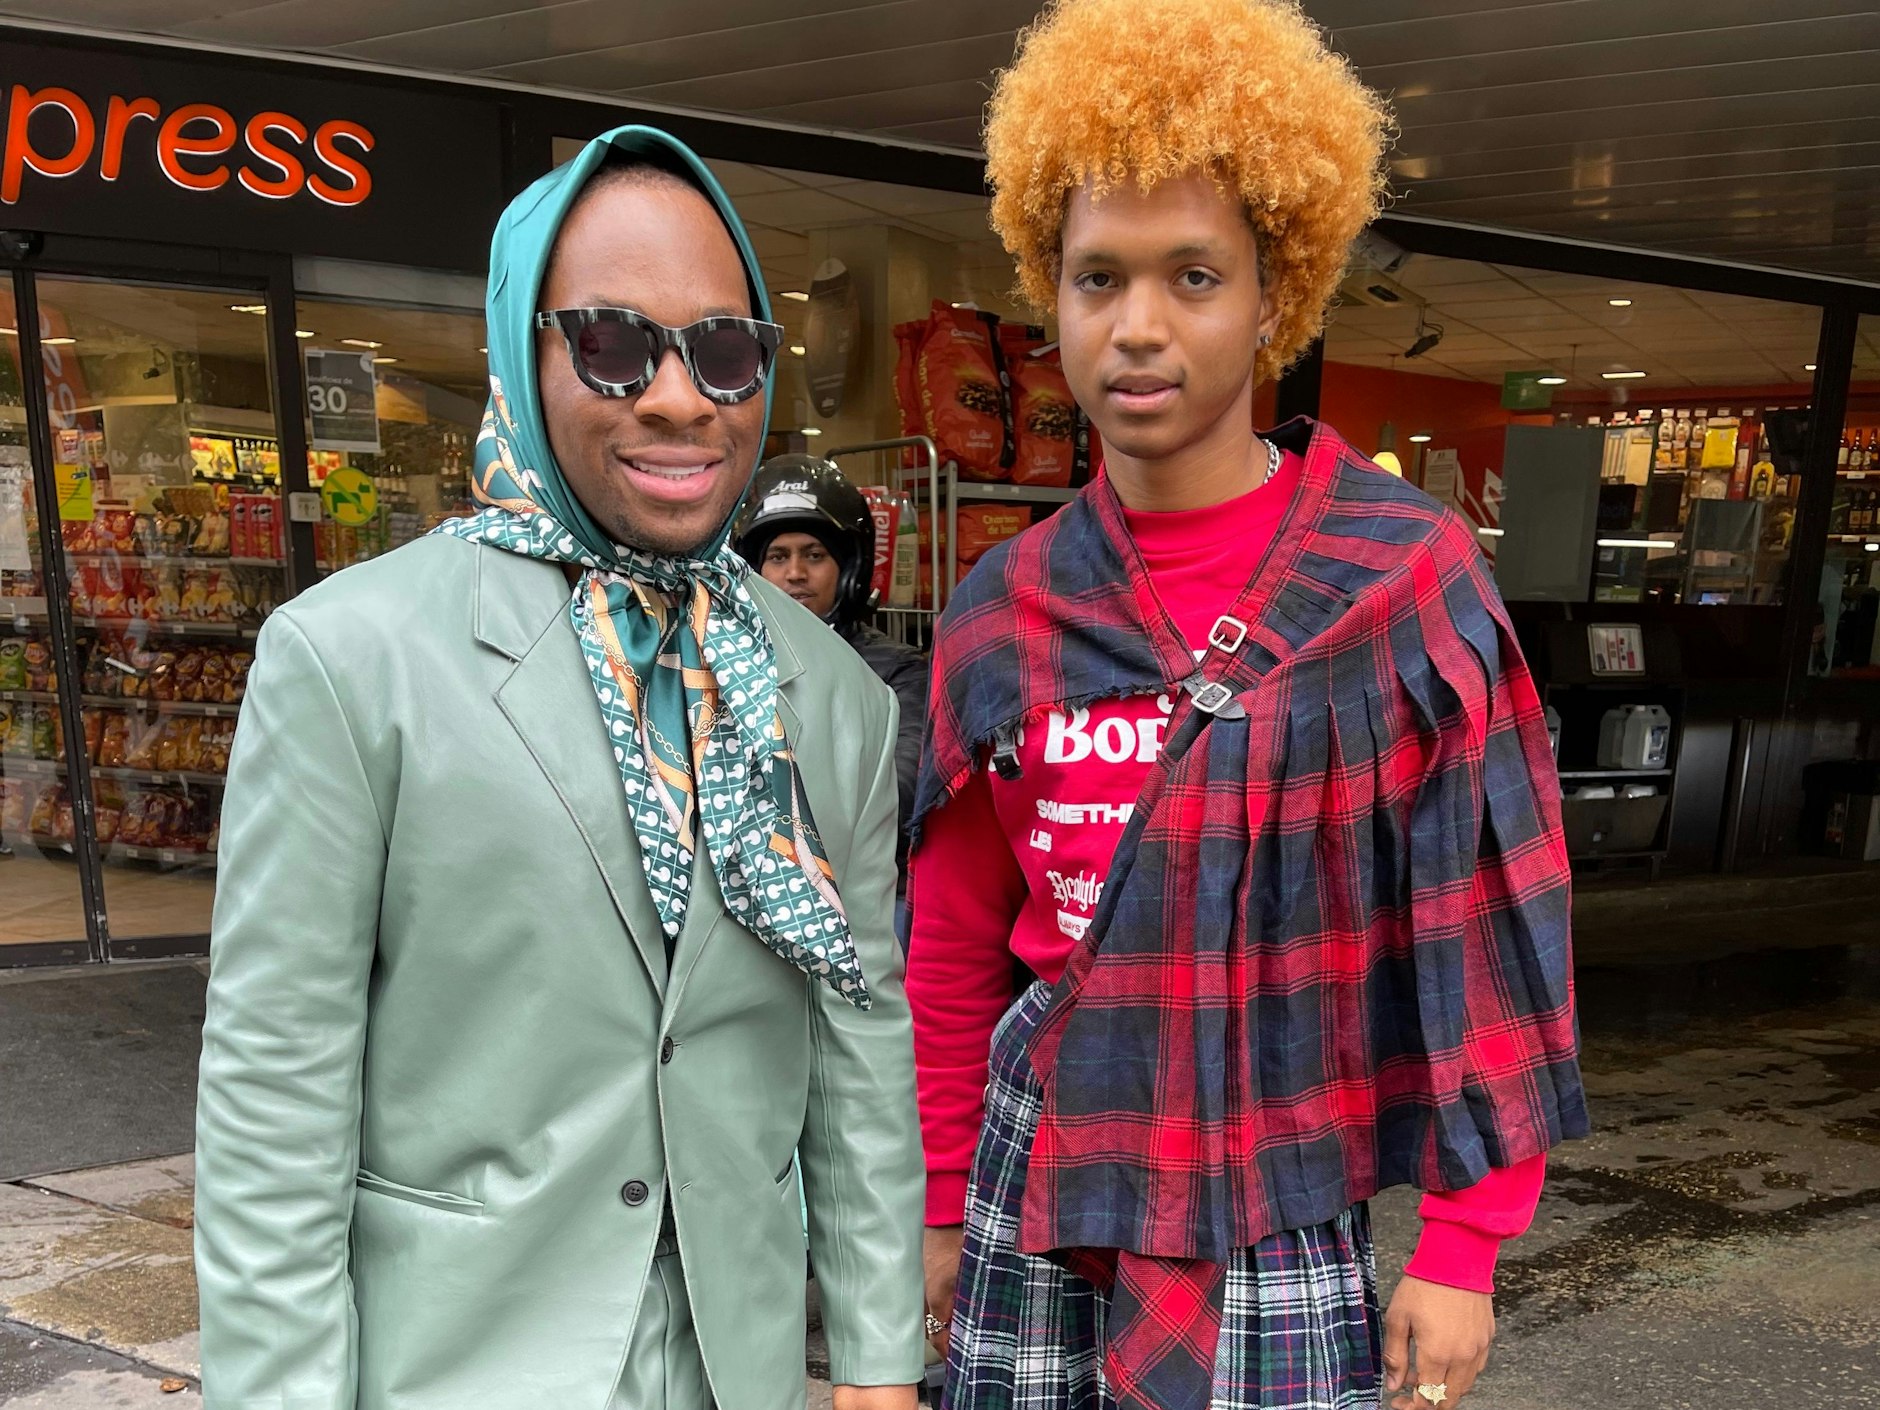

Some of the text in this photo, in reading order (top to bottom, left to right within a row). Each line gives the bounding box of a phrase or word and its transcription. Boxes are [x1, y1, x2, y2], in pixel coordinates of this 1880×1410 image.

[0, 84, 375, 206] press
[308, 384, 347, 413] 30
[770, 480, 808, 493] Arai
